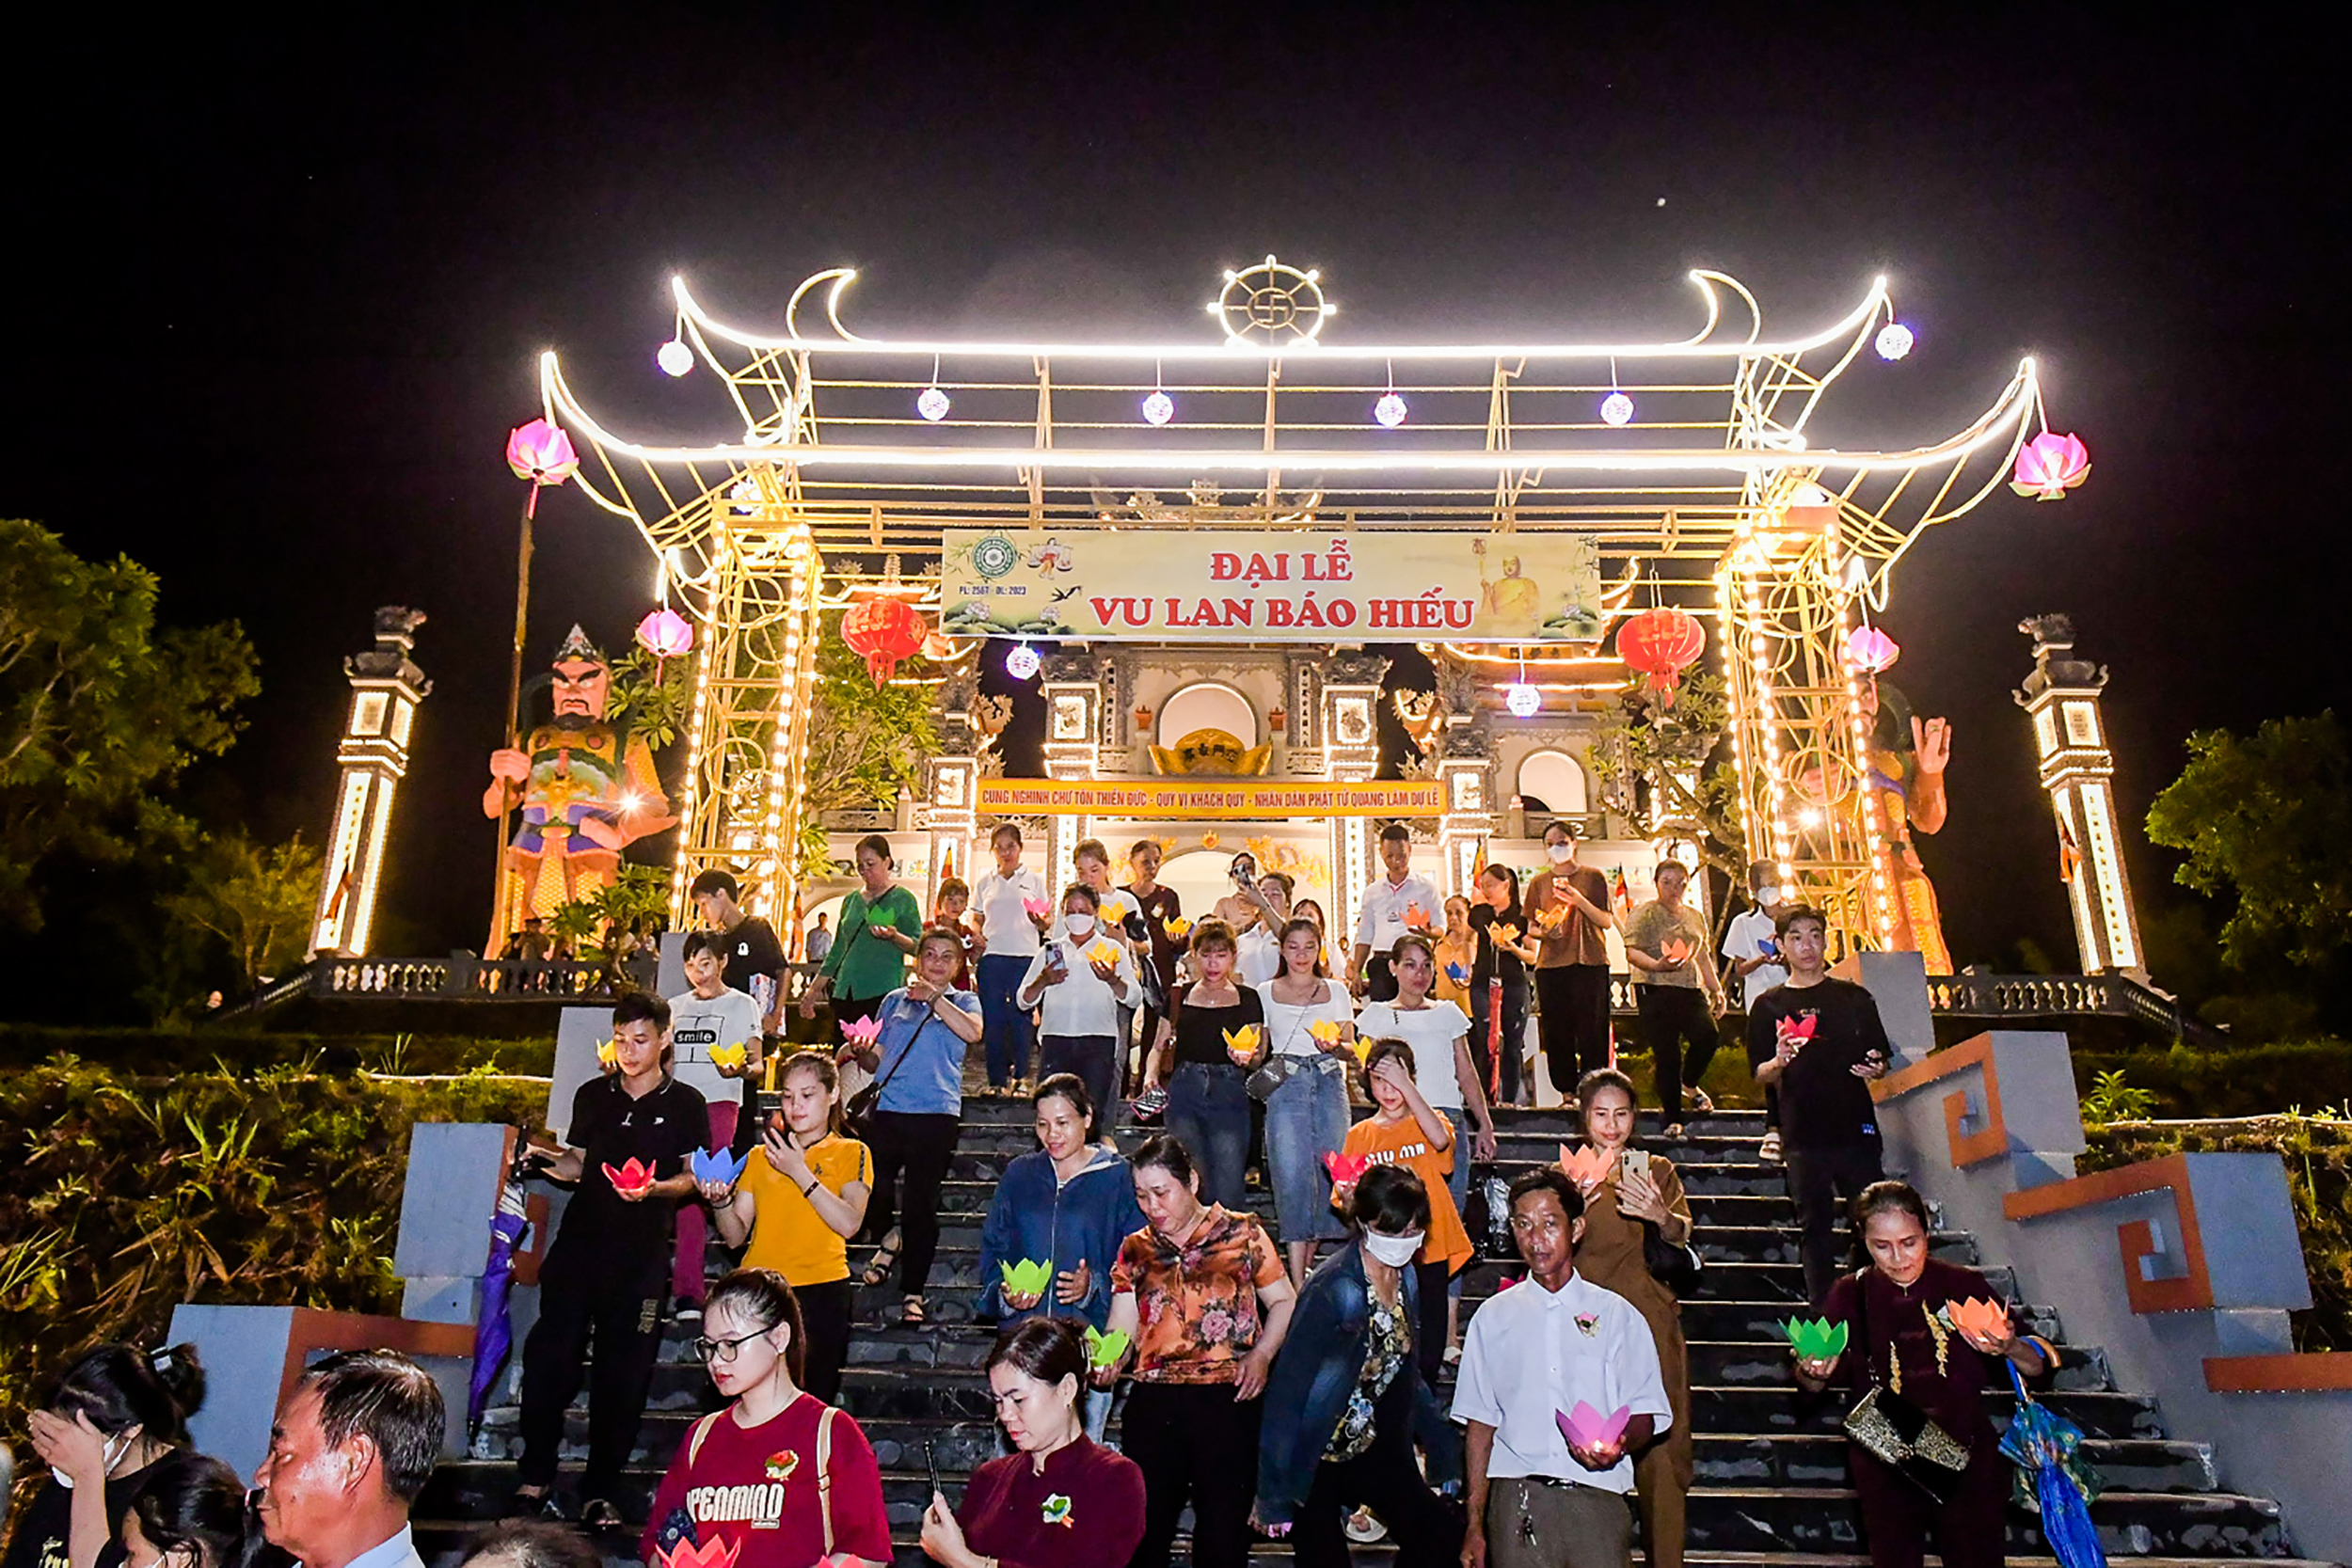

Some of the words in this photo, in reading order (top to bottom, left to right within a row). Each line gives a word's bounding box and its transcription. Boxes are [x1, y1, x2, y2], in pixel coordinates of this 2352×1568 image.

[1210, 552, 1289, 589] ĐẠI
[1300, 538, 1353, 581] LỄ
[1089, 597, 1153, 626] VU
[1165, 597, 1254, 626] LAN
[1265, 591, 1357, 627] BÁO
[1368, 587, 1474, 628] HIẾU
[982, 789, 1009, 804] CUNG
[1012, 789, 1050, 805] NGHINH
[1179, 792, 1188, 810] VỊ
[1351, 792, 1384, 809] QUANG
[677, 1031, 713, 1042] smile
[687, 1483, 785, 1523] PENMIND
